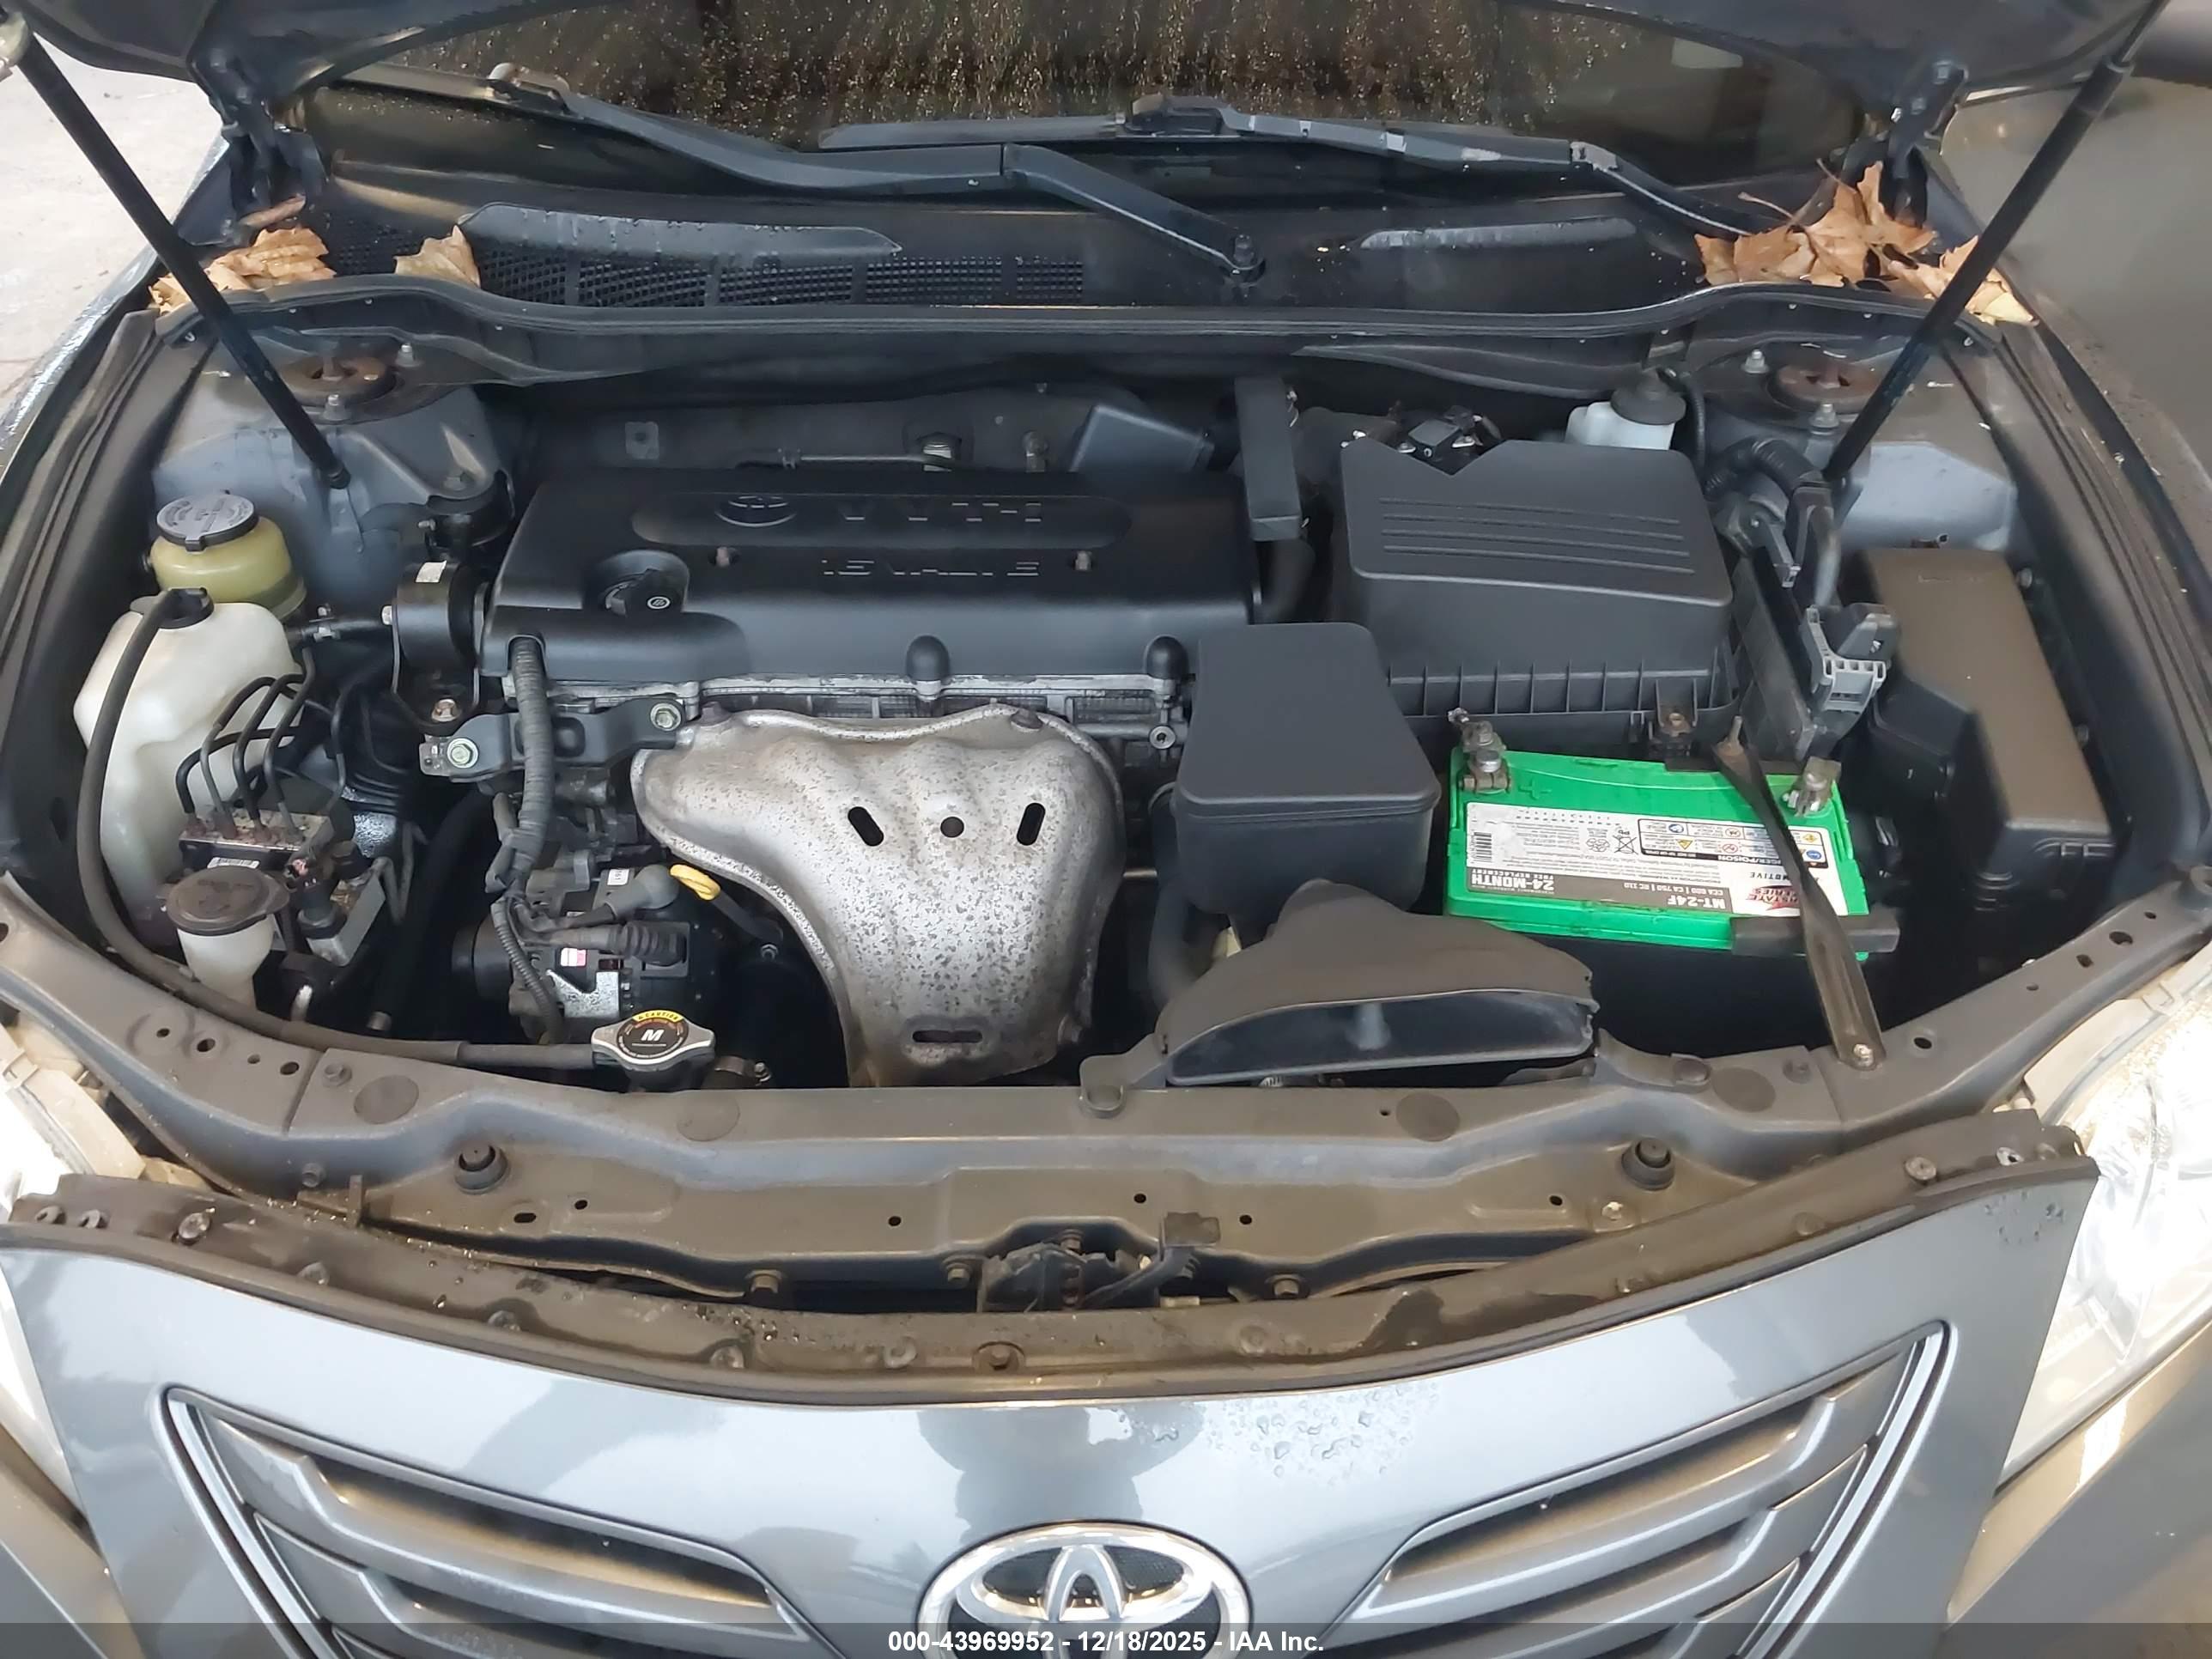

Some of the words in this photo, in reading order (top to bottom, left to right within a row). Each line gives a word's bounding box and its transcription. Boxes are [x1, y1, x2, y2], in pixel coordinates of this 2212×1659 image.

[1717, 854, 1781, 865] GER/POISON
[1471, 873, 1555, 891] 24-MONTH
[1750, 872, 1790, 880] MOTIVE
[1668, 895, 1726, 909] MT-24F
[641, 1029, 665, 1041] M
